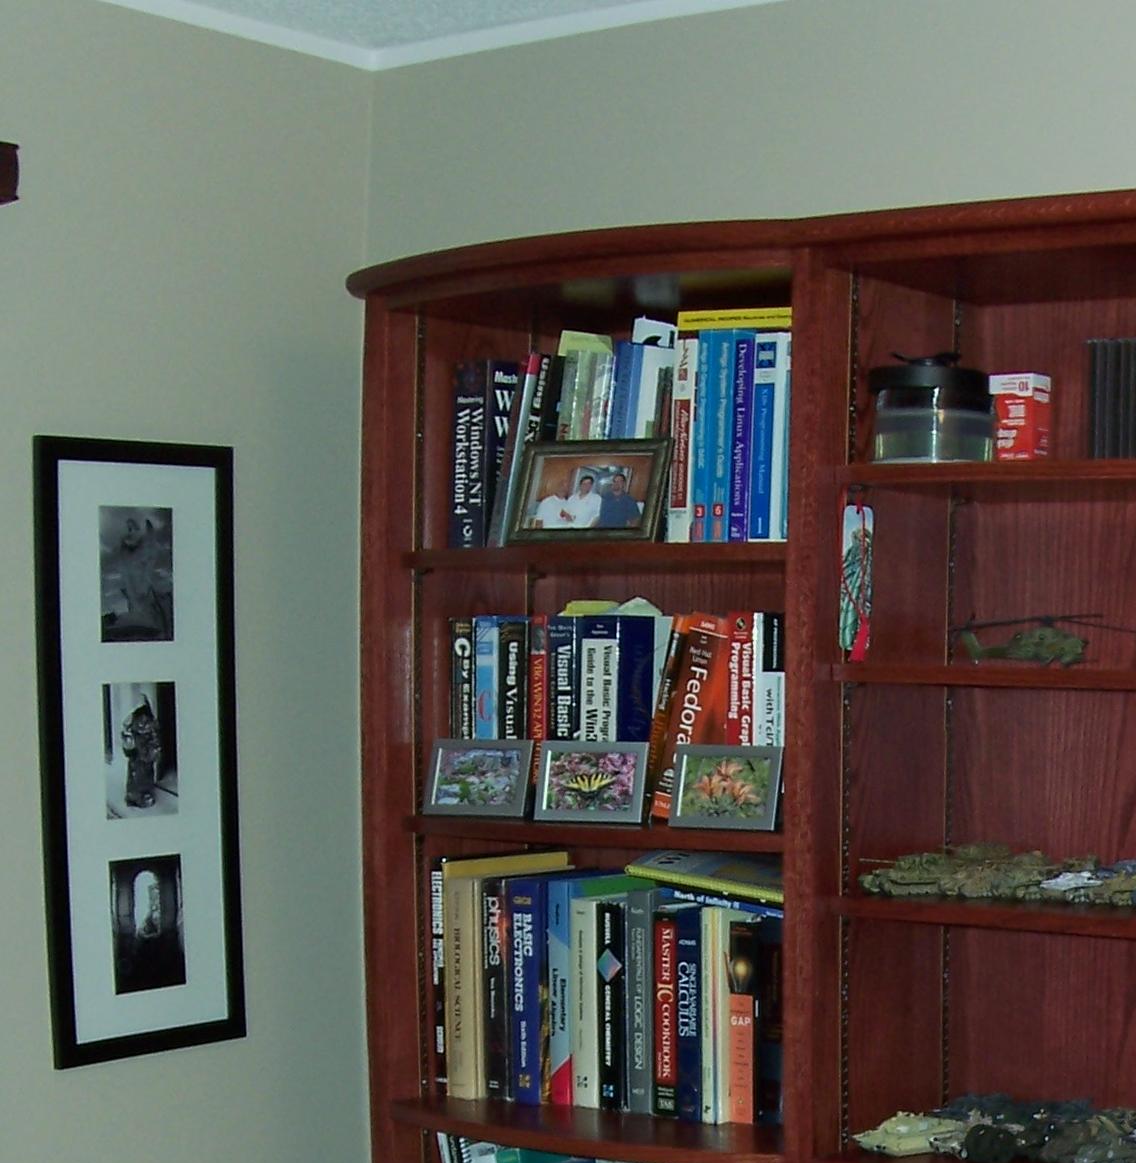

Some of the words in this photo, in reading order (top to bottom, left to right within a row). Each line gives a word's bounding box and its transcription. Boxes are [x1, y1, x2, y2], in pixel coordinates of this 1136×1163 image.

[735, 343, 747, 404] Developing
[469, 407, 484, 480] Windows
[735, 407, 745, 438] Linux
[454, 407, 470, 504] Workstation
[732, 441, 744, 507] Applications
[454, 505, 468, 515] 4
[469, 482, 481, 506] NT
[506, 641, 518, 686] Using
[556, 644, 571, 692] Visual
[586, 647, 596, 676] Guide
[602, 645, 612, 677] Visual
[728, 642, 740, 719] Programming
[741, 642, 751, 678] Visual
[586, 676, 595, 688] to
[586, 689, 596, 705] the
[602, 679, 612, 707] Basic
[741, 680, 751, 710] Basic
[766, 688, 774, 714] with
[505, 687, 518, 739] Visual
[556, 695, 571, 737] Basic
[676, 665, 708, 745] Fedora
[431, 871, 444, 935] ELECTRONICS
[673, 890, 694, 903] North
[486, 896, 500, 966] physics
[523, 913, 533, 957] BASIC
[513, 912, 524, 1012] ELECTRONICS
[661, 928, 673, 981] MASTER
[634, 995, 643, 1029] LOGIC
[656, 983, 674, 1003] IC
[678, 961, 688, 1037] CALCULUS
[634, 1032, 643, 1070] DESIGN
[662, 1003, 671, 1078] COOKBOOK
